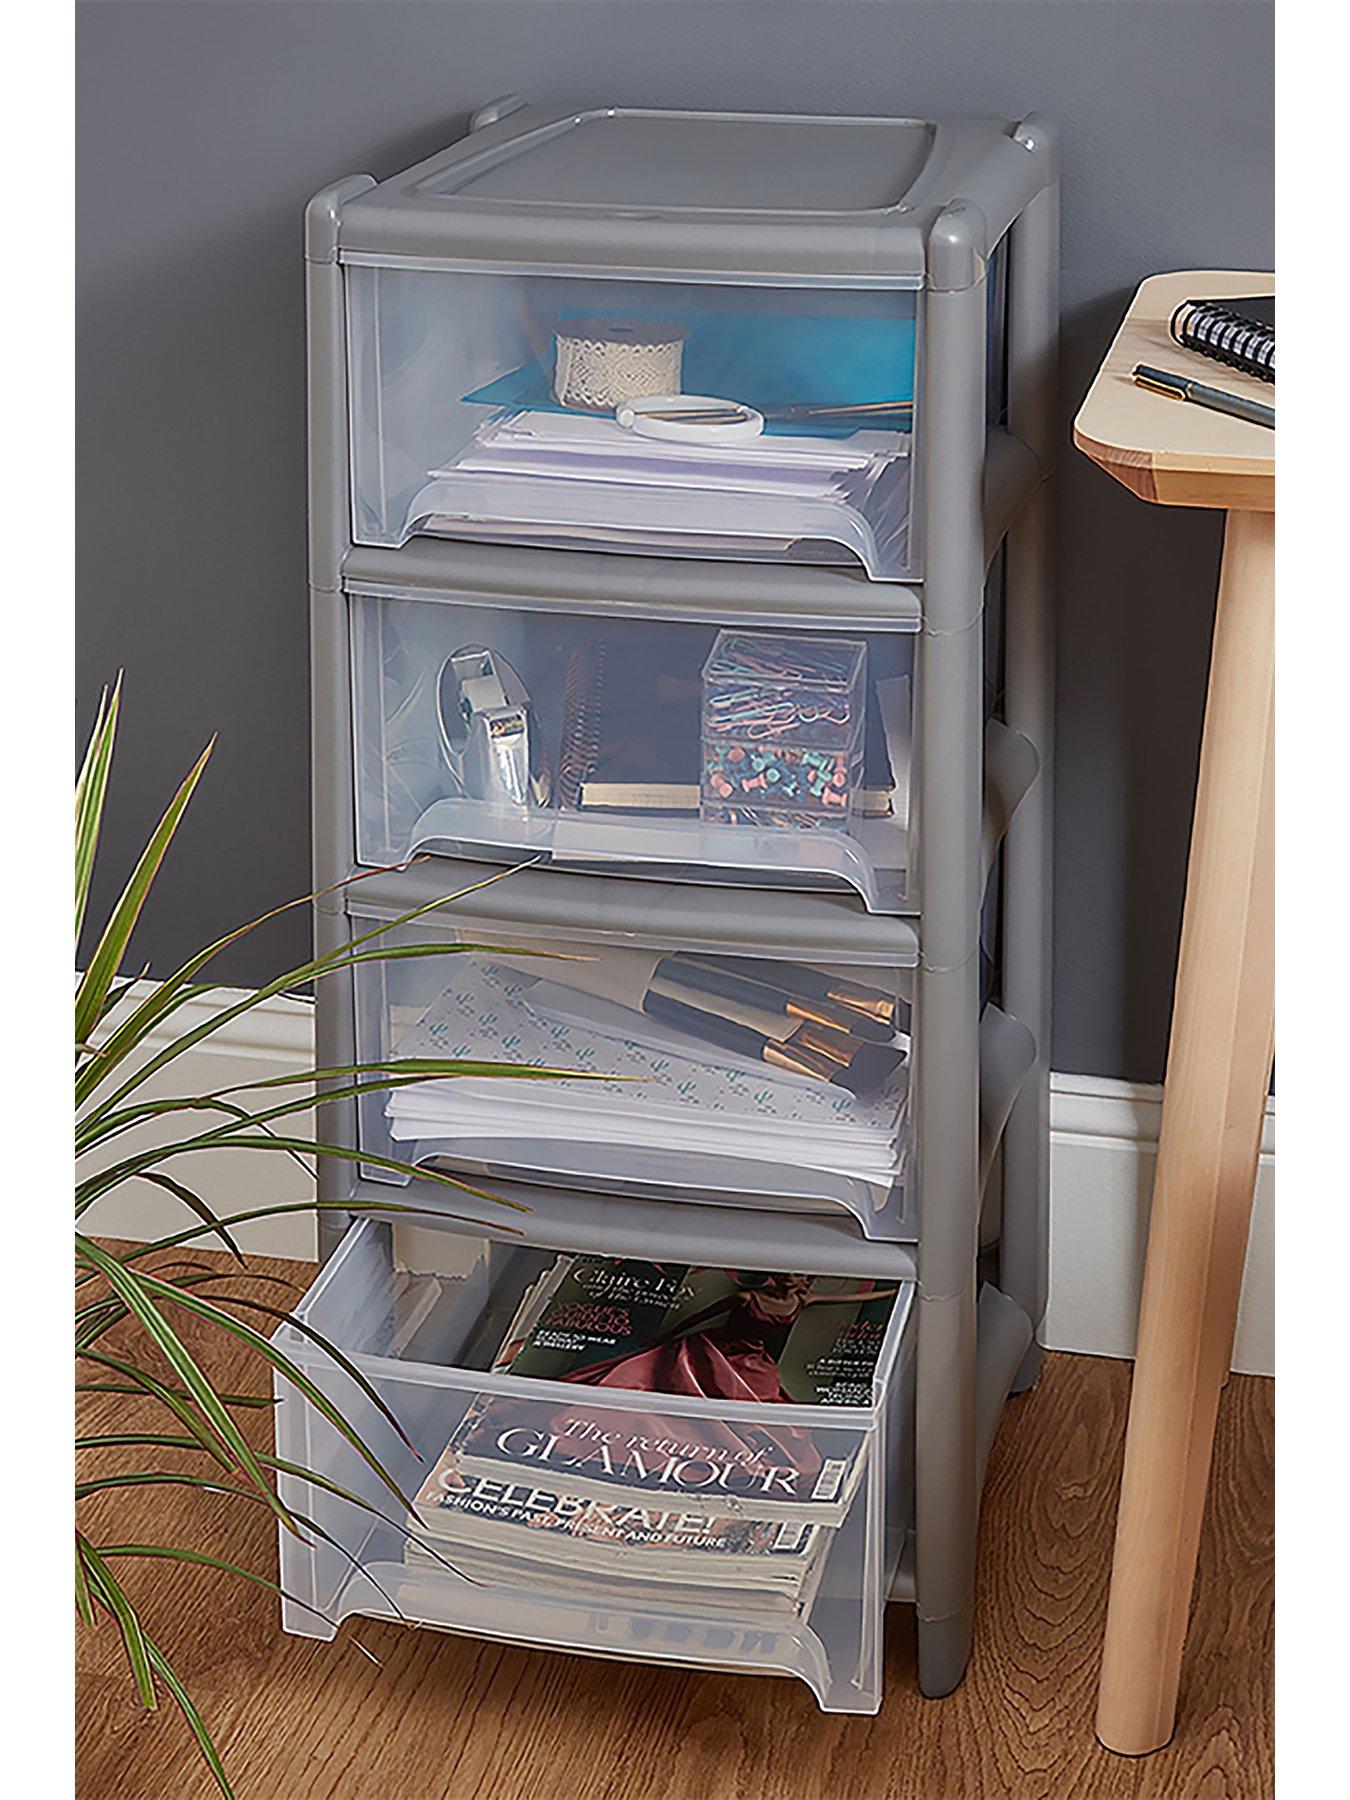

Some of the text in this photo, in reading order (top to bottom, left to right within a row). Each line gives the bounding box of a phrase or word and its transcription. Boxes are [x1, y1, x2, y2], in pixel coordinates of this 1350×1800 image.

[496, 1427, 800, 1496] GLAMOUR
[560, 1416, 774, 1469] The return of
[425, 1491, 509, 1517] FASHION'S
[554, 1517, 624, 1539] PRESENT
[624, 1530, 661, 1543] AND
[660, 1533, 727, 1548] FUTURE
[437, 1468, 718, 1534] CELEBRATE!
